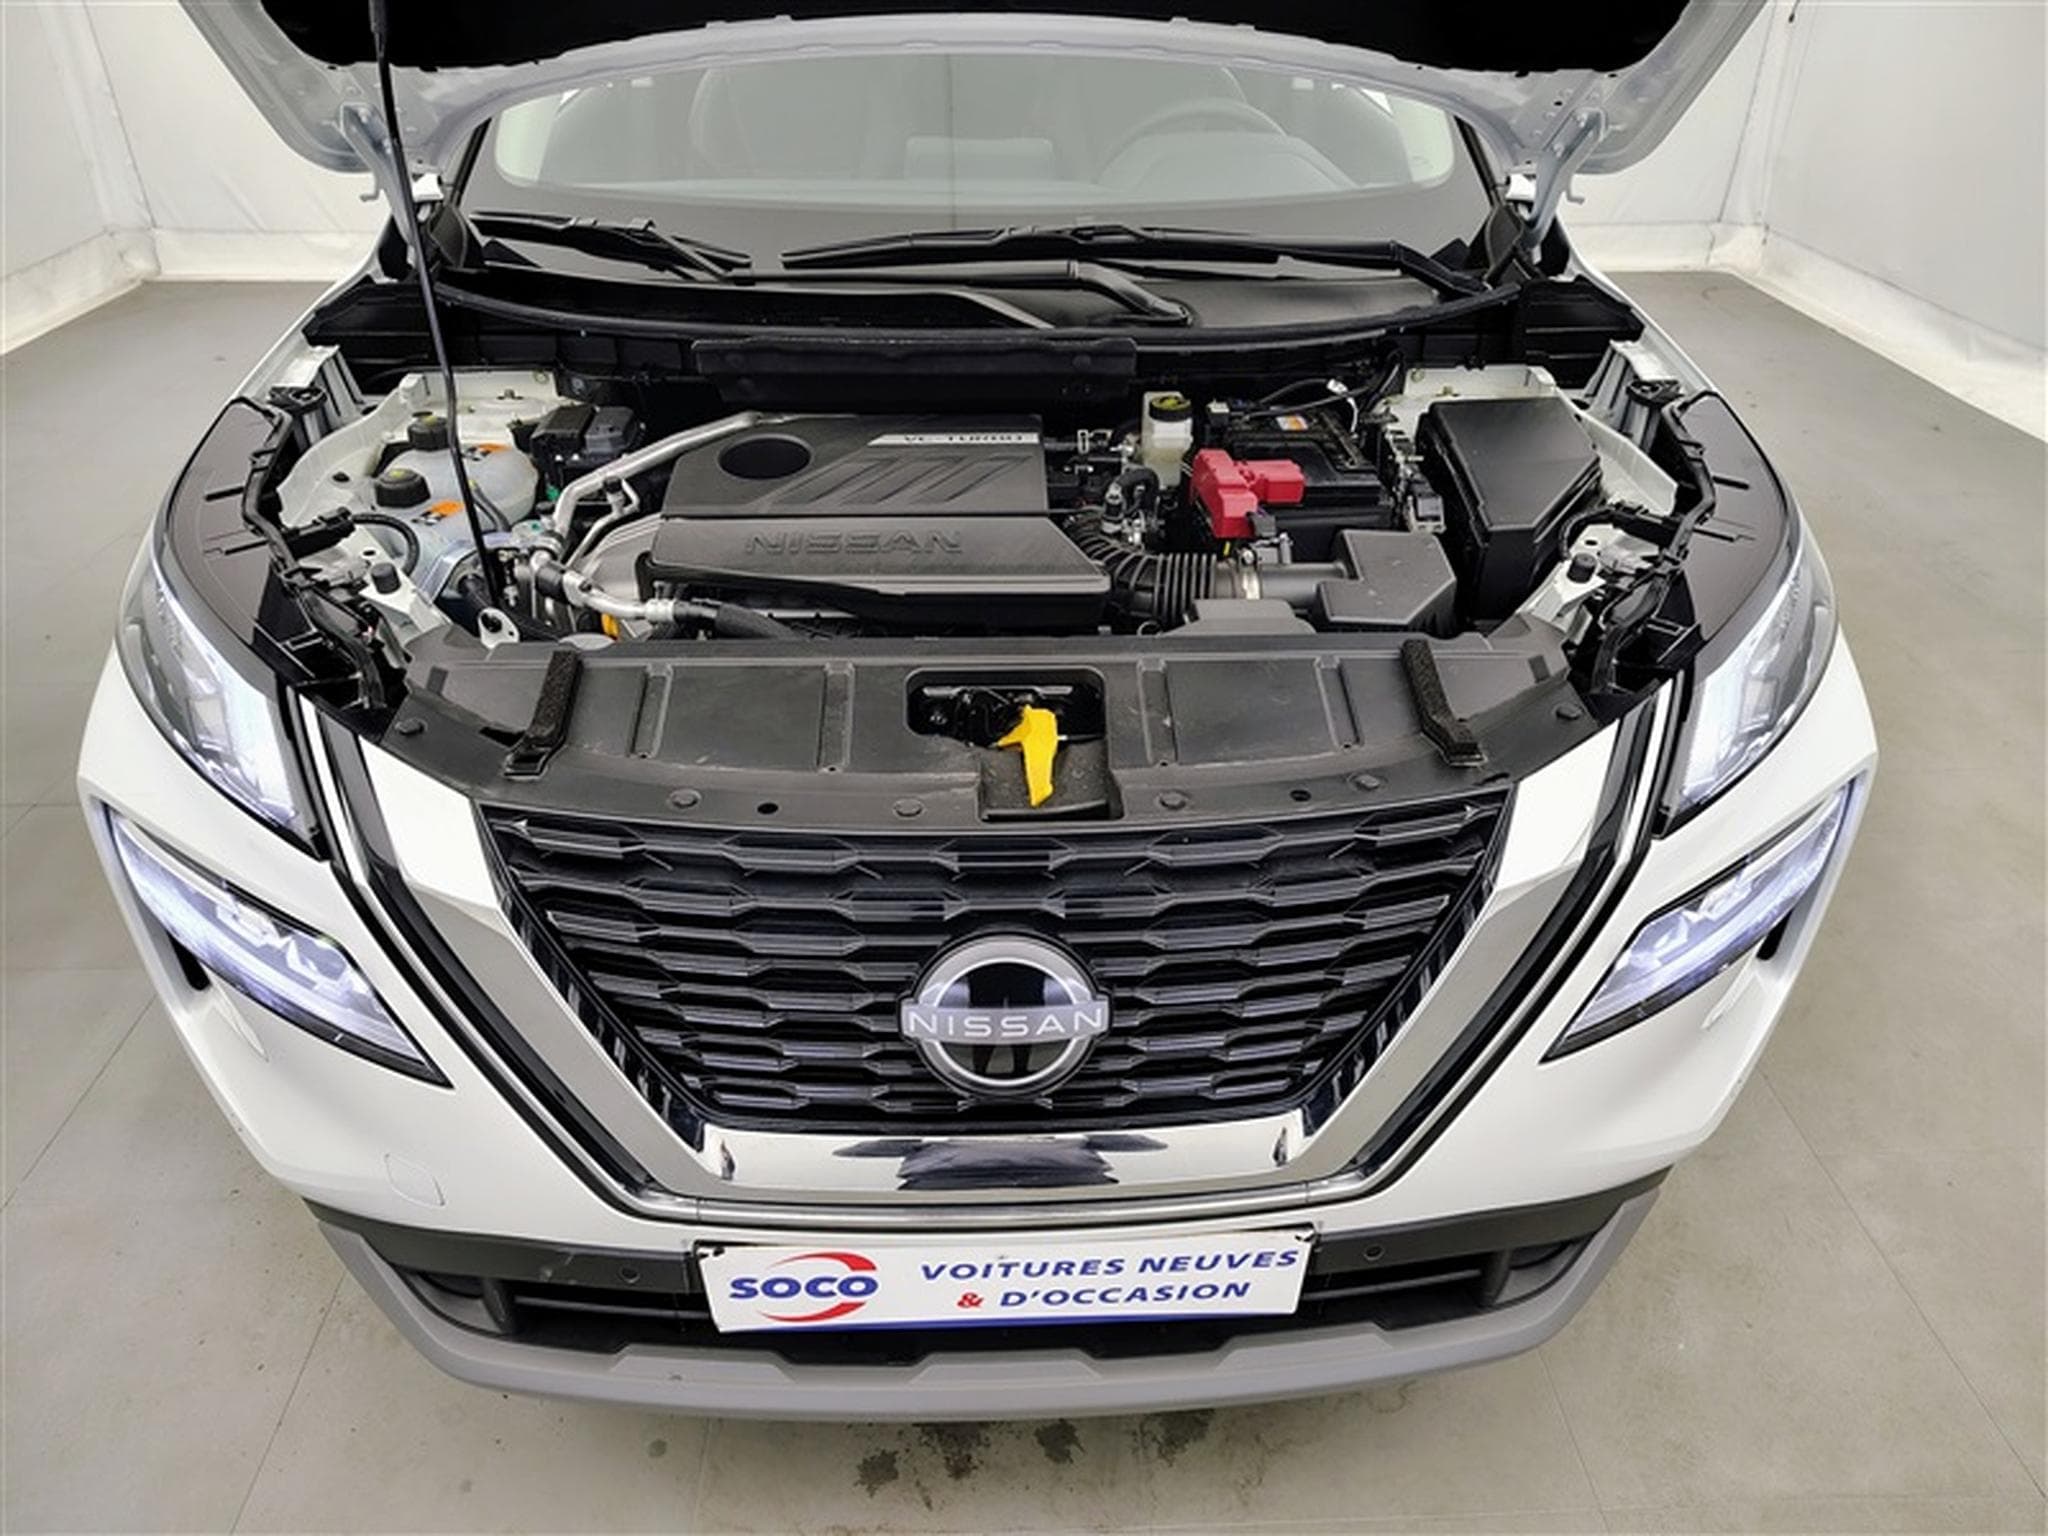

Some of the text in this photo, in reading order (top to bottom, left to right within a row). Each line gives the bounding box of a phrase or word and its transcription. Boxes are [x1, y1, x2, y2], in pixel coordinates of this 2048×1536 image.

[746, 531, 962, 555] NISSAN
[908, 1008, 1101, 1037] NISSAN
[921, 1251, 1298, 1280] VOITURES NEUVES
[729, 1275, 878, 1299] SOCO
[957, 1282, 1250, 1309] & D'OCCASION
